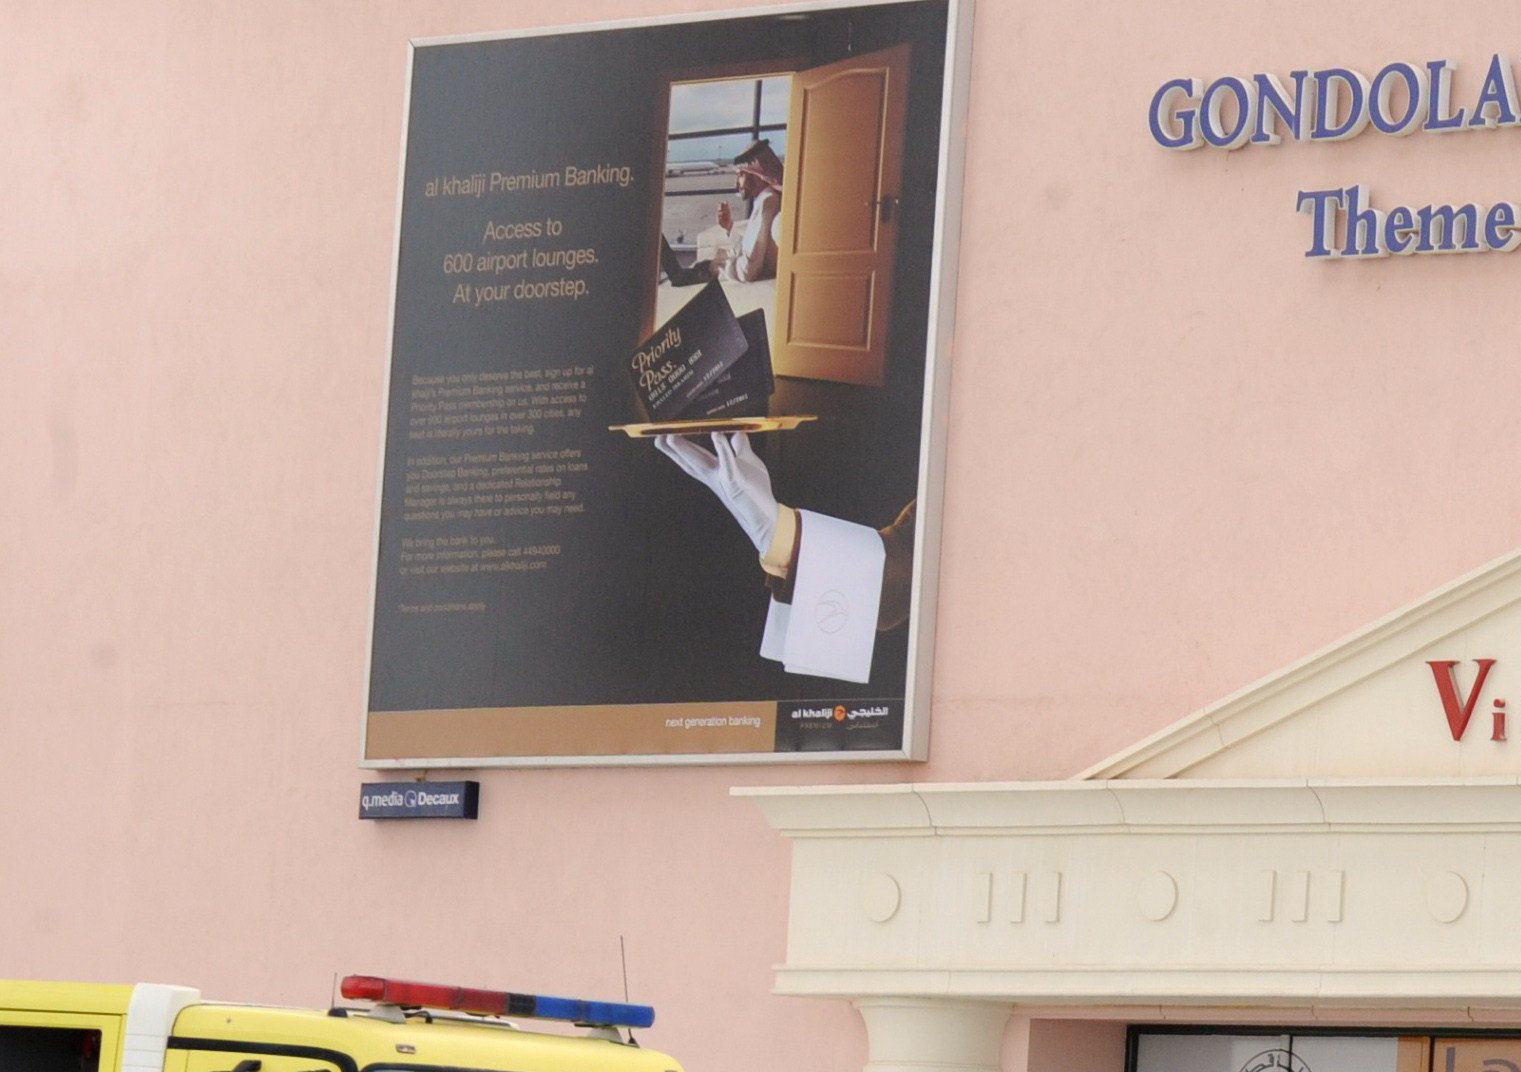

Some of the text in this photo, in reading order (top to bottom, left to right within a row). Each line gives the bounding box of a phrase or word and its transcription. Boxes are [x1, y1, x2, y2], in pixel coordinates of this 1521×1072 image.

[425, 163, 634, 198] al khaliji Premium Banking.
[483, 217, 563, 244] Access to
[443, 248, 598, 274] 600 airport lounges.
[453, 279, 589, 307] At your doorstep.
[632, 328, 682, 373] Priority
[666, 716, 761, 729] next generation banking
[791, 708, 833, 719] al khaliji
[362, 791, 459, 811] q.media Decaux
